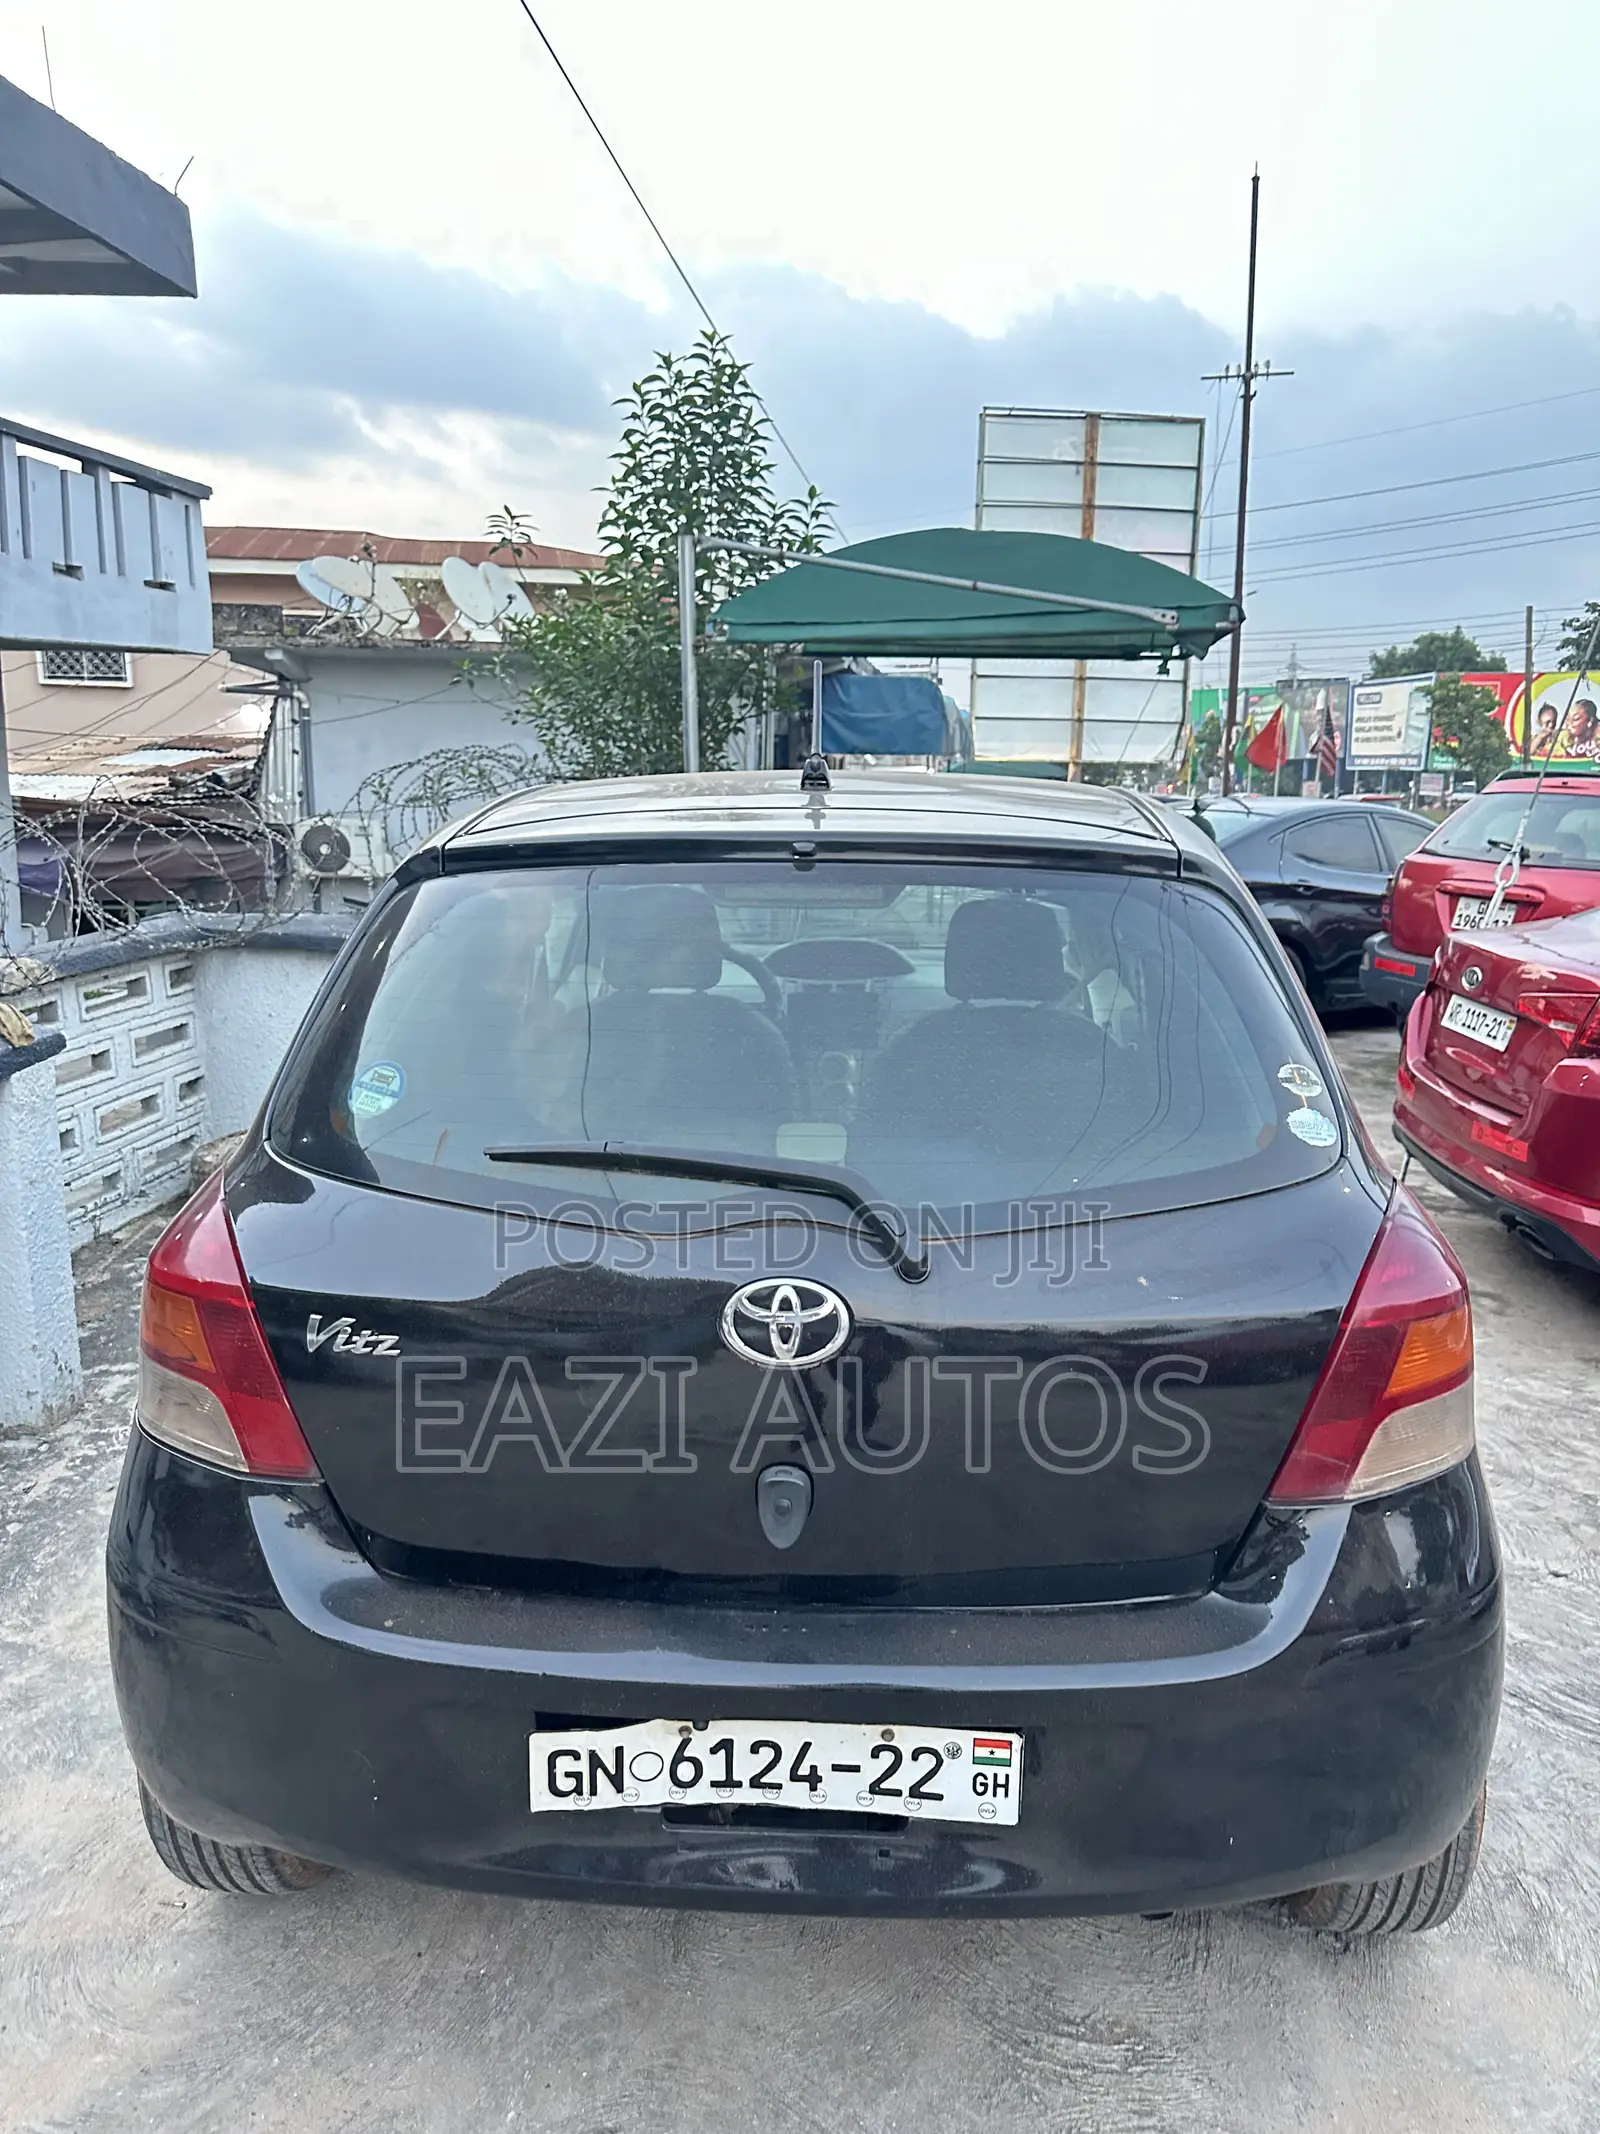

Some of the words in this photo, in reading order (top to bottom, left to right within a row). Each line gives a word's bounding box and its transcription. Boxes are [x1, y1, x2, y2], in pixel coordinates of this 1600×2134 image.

[1461, 1008, 1502, 1040] 1117-21
[306, 1313, 401, 1356] Vitz
[547, 1745, 624, 1798] GN
[669, 1737, 944, 1802] 6124-22
[972, 1771, 1010, 1798] GH
